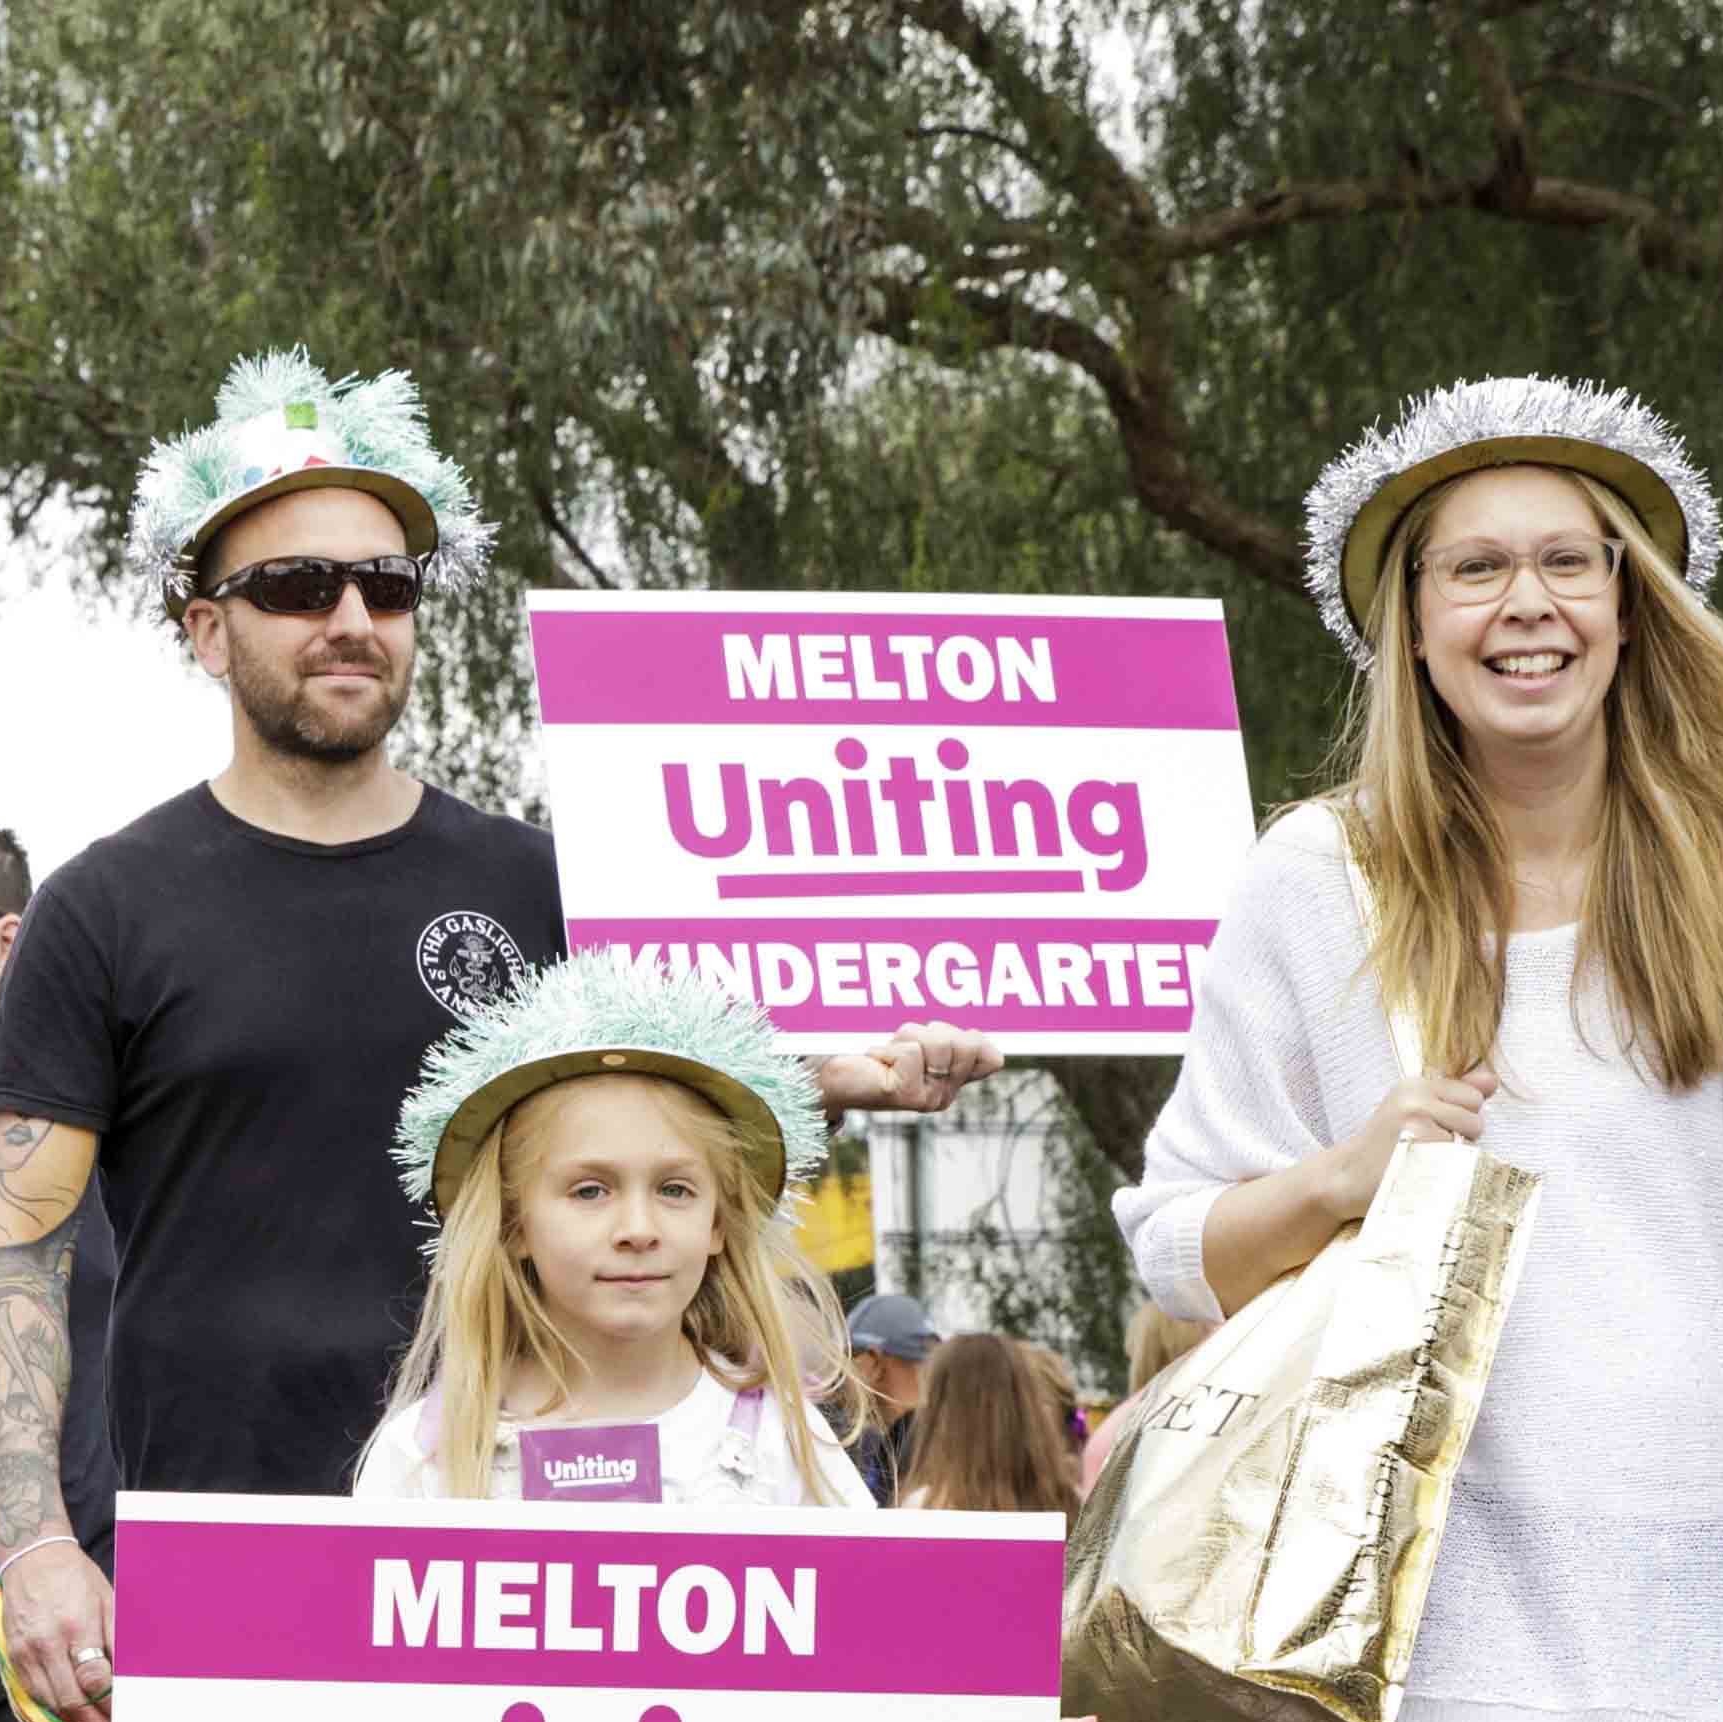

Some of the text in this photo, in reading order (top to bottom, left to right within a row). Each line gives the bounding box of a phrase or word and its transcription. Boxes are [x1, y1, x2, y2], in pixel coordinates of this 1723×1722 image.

[723, 633, 1057, 703] MELTON
[661, 736, 1148, 892] Uniting
[422, 926, 448, 967] THE
[544, 1453, 637, 1482] Uniting
[372, 1559, 818, 1656] MELTON
